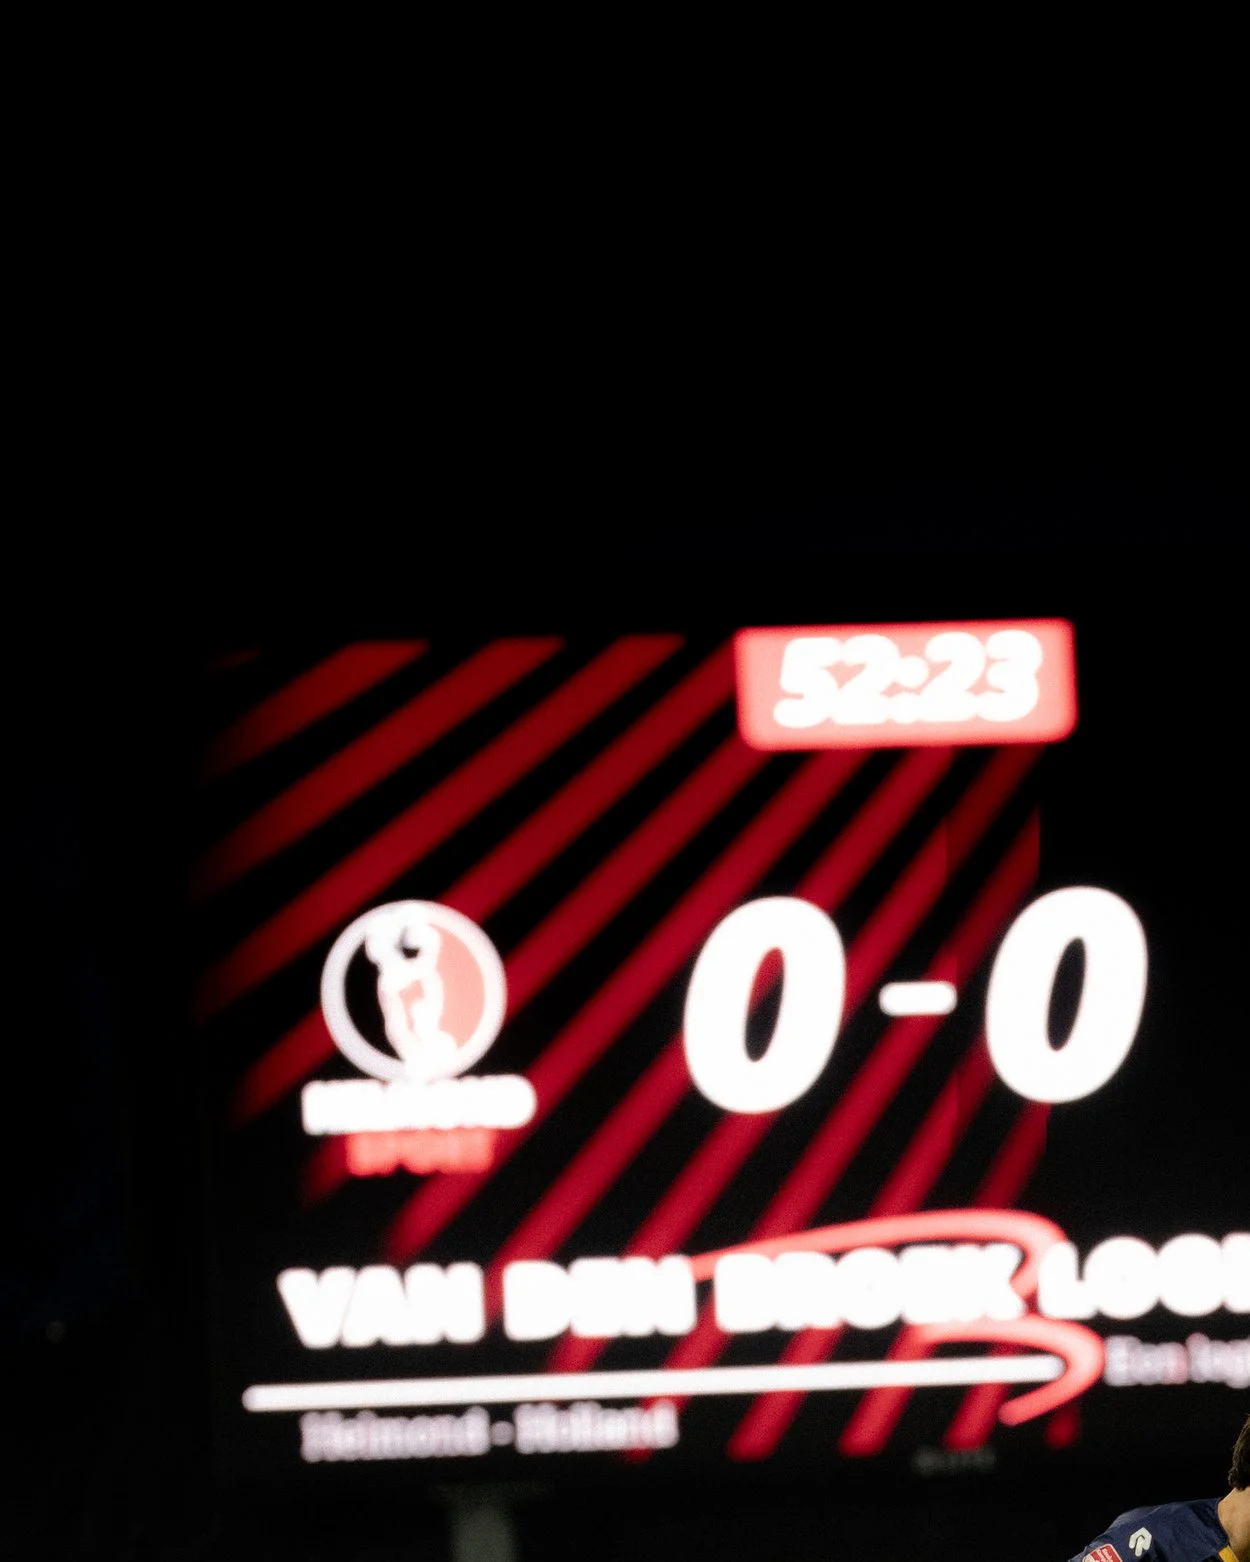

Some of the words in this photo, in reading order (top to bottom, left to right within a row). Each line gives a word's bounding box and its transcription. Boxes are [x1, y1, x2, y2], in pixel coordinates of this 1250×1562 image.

[774, 629, 1043, 729] 52:23
[684, 896, 846, 1115] 0
[985, 886, 1148, 1104] 0
[277, 1263, 486, 1349] VAN
[503, 1254, 697, 1341] DEN
[714, 1244, 1023, 1333] BROEK
